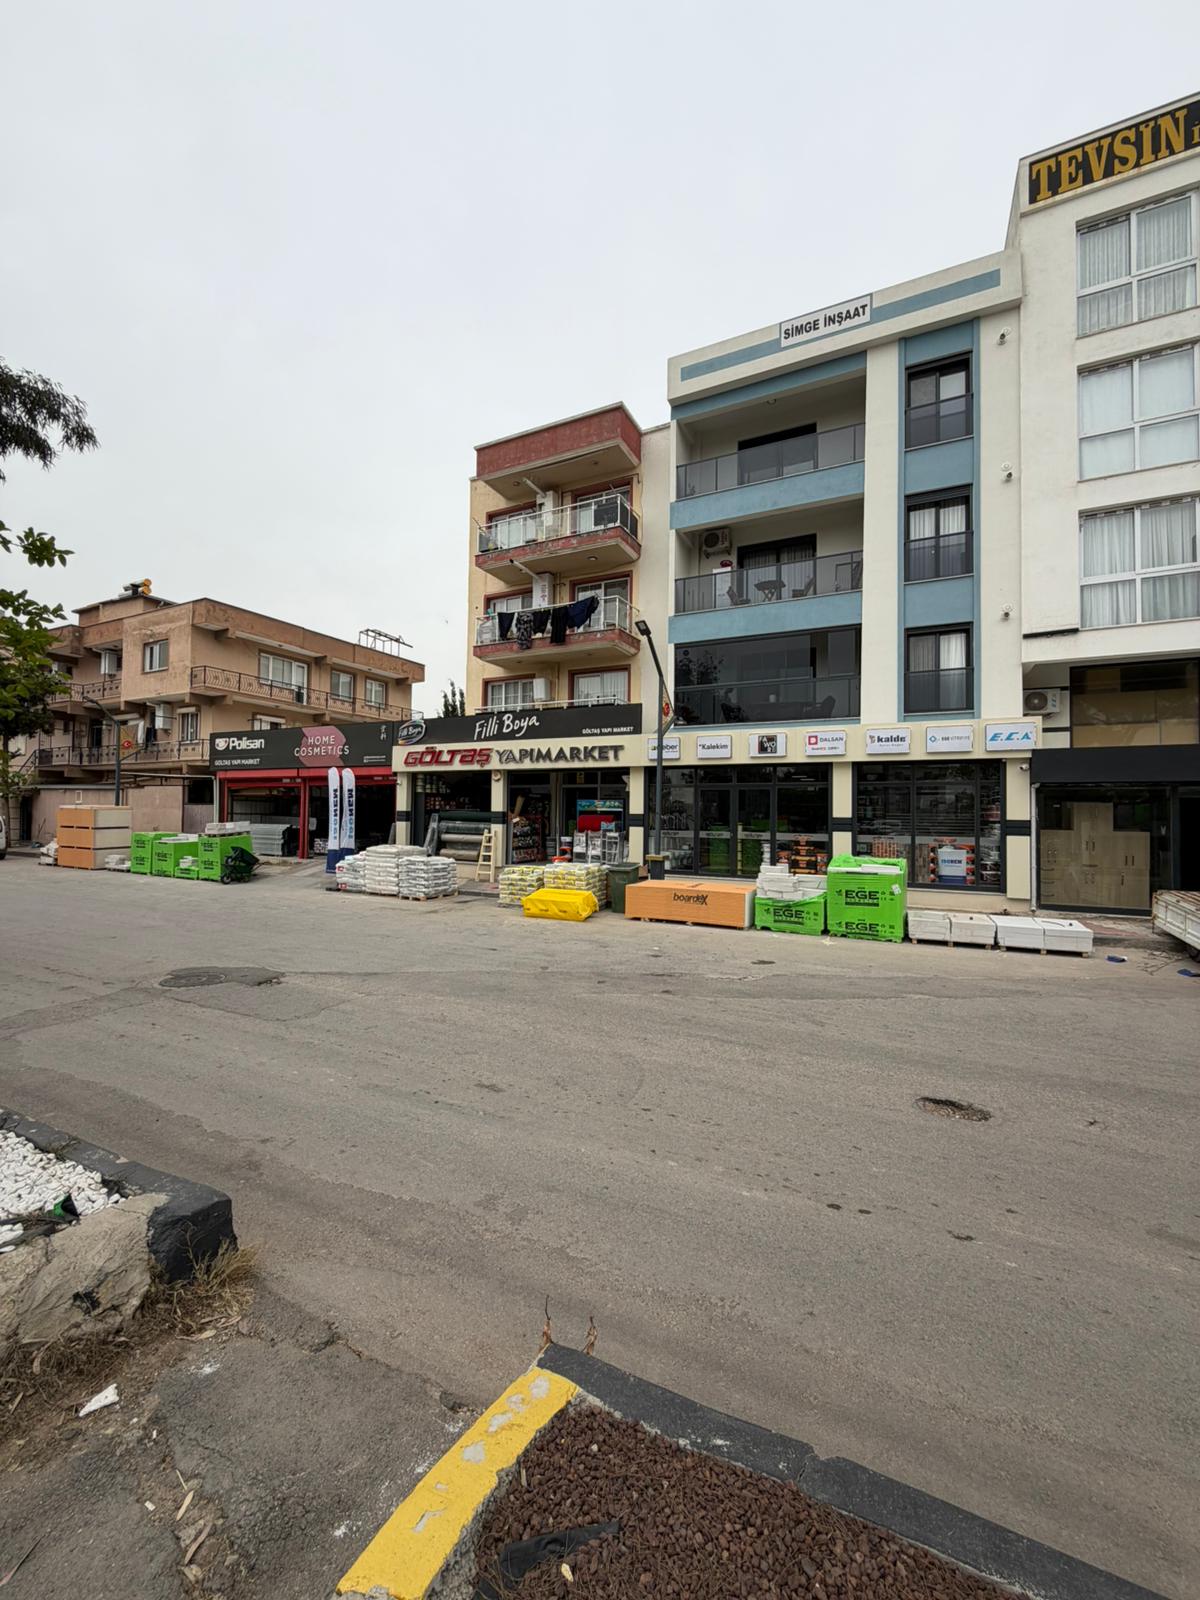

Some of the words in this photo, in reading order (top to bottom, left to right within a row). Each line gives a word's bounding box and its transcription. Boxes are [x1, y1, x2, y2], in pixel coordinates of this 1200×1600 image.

[783, 318, 820, 340] SİMGE
[823, 304, 868, 326] İNŞAAT
[474, 715, 499, 741] Filli
[502, 713, 540, 737] Boya
[229, 736, 265, 750] Polisan
[308, 735, 336, 745] HOME
[294, 745, 350, 757] COSMETICS
[845, 889, 880, 900] EGE
[773, 907, 805, 919] EGE
[845, 921, 880, 933] EGE
